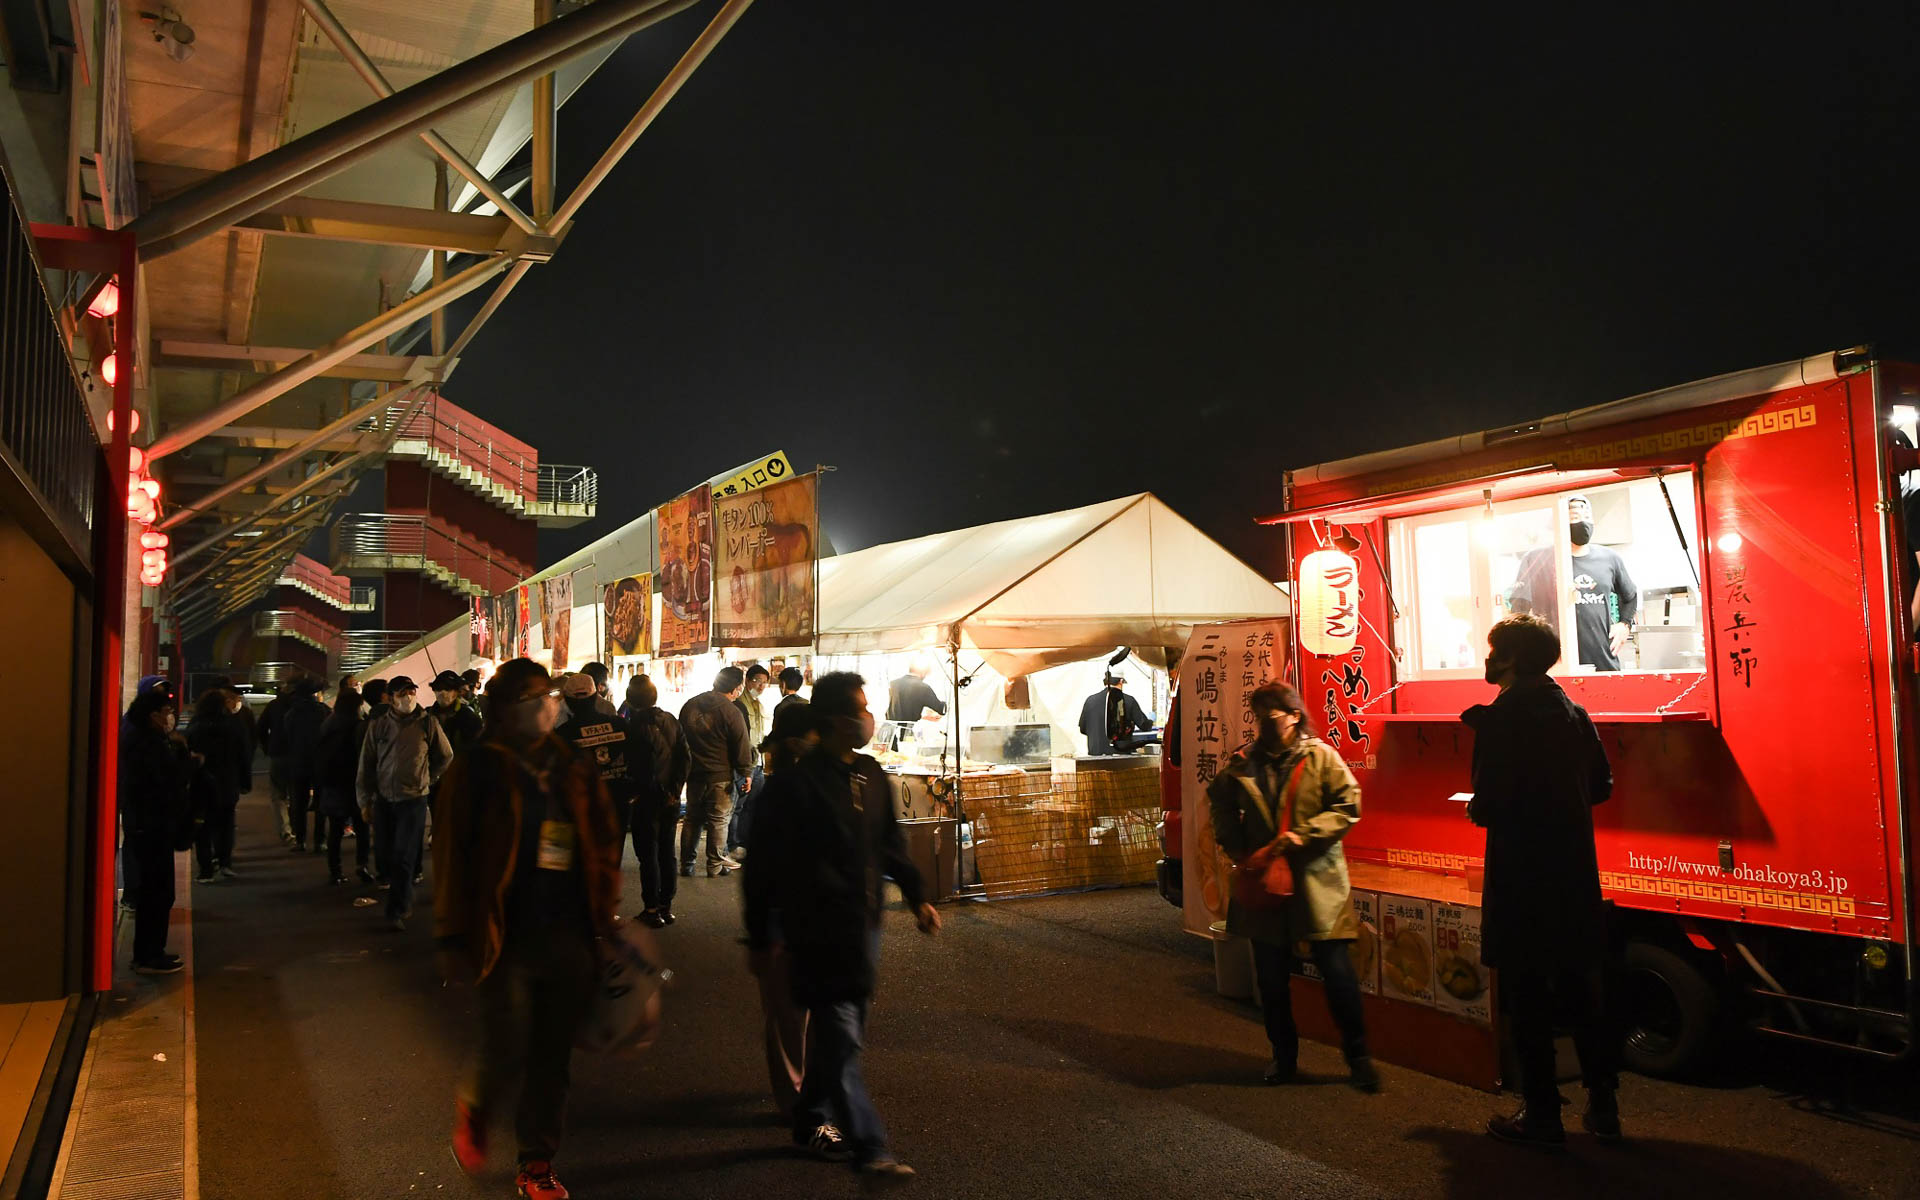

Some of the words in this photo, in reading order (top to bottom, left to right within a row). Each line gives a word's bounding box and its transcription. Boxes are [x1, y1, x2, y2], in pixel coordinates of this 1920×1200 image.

[741, 468, 768, 491] 入口
[1323, 566, 1355, 638] ラーメン
